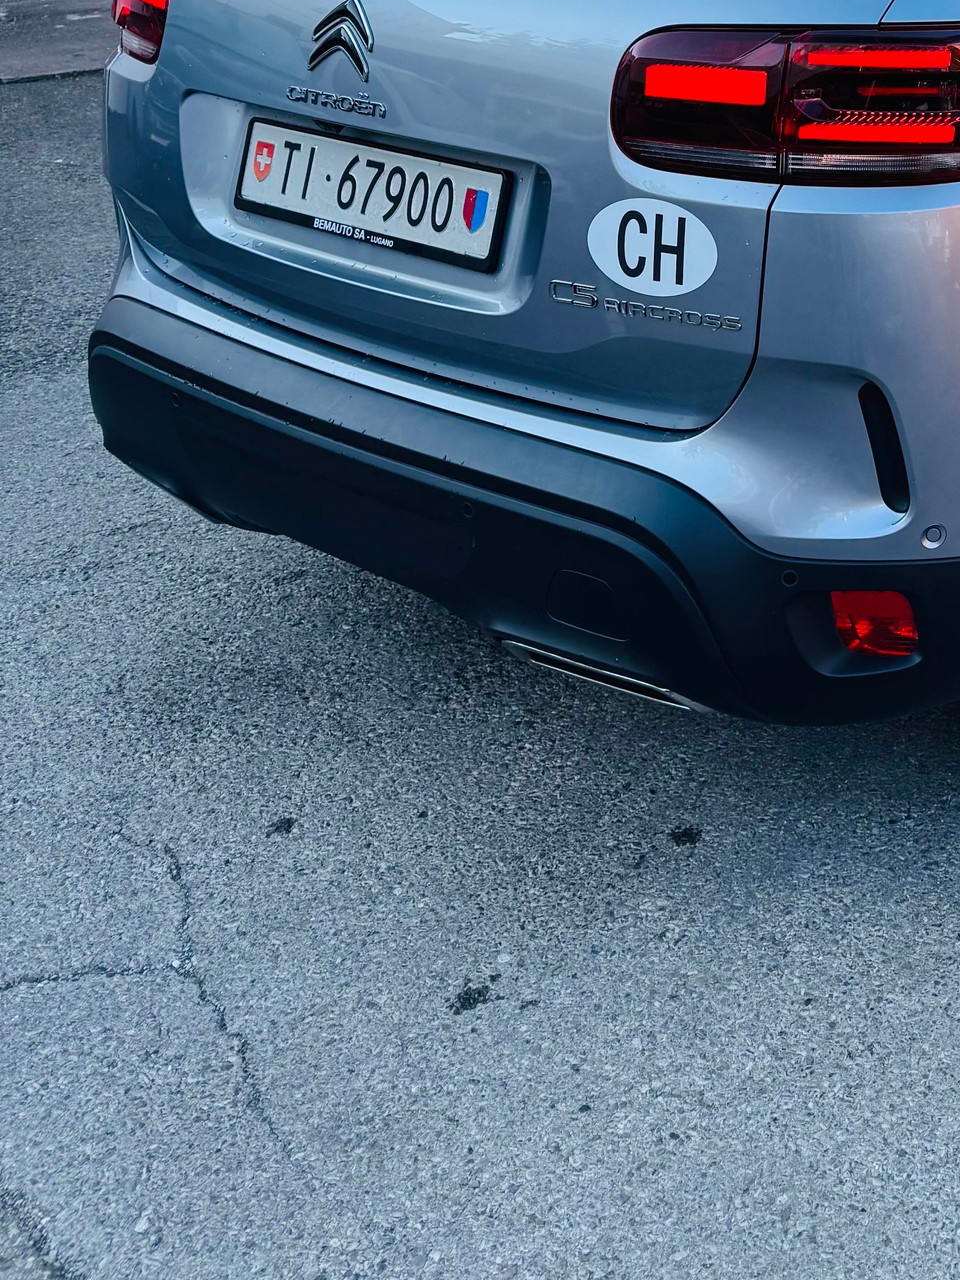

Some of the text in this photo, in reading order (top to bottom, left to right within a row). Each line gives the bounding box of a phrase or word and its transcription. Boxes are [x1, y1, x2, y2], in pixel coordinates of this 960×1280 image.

[313, 218, 353, 237] BEMAUTO
[353, 228, 365, 240] SA
[370, 235, 394, 248] LUGANO
[617, 209, 686, 286] CH
[549, 279, 743, 331] C5 AIRCROSS
